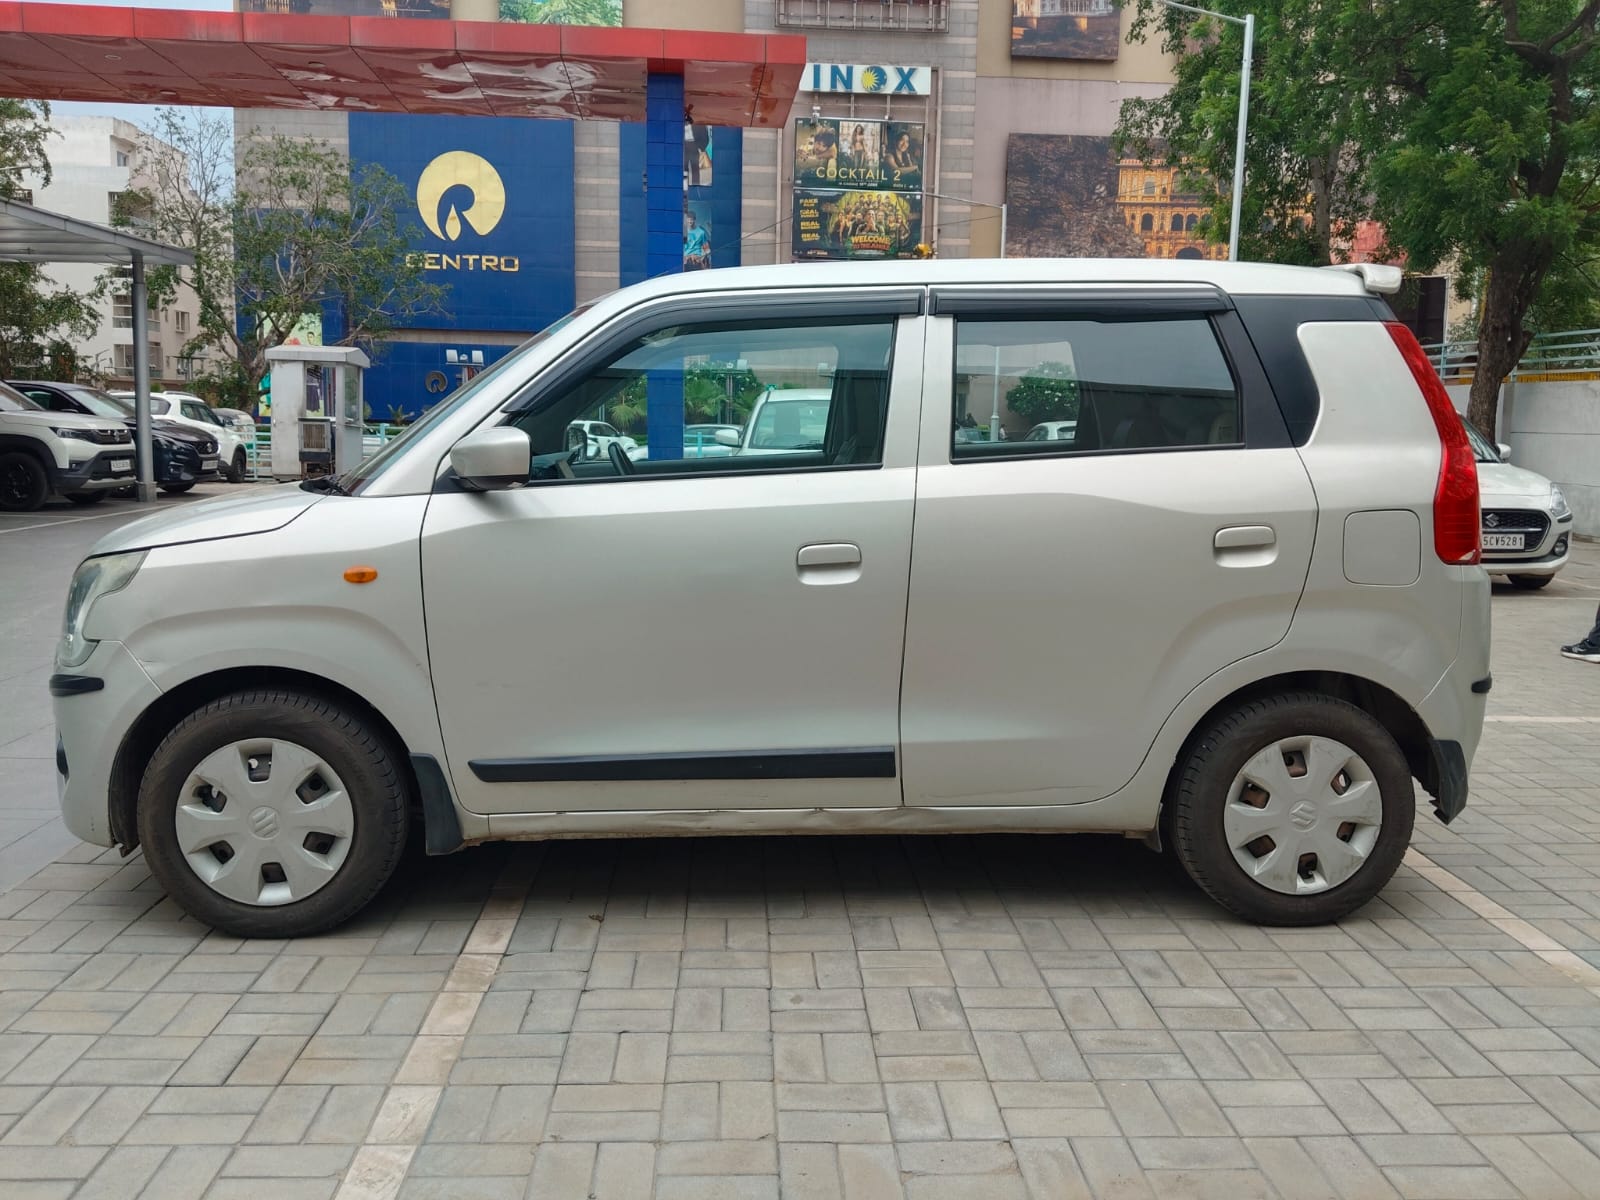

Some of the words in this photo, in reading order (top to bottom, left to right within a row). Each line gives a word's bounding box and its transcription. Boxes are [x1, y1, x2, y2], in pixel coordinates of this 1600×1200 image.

[813, 64, 917, 93] INOX
[816, 166, 888, 181] COCKTAIL
[893, 170, 901, 181] 2
